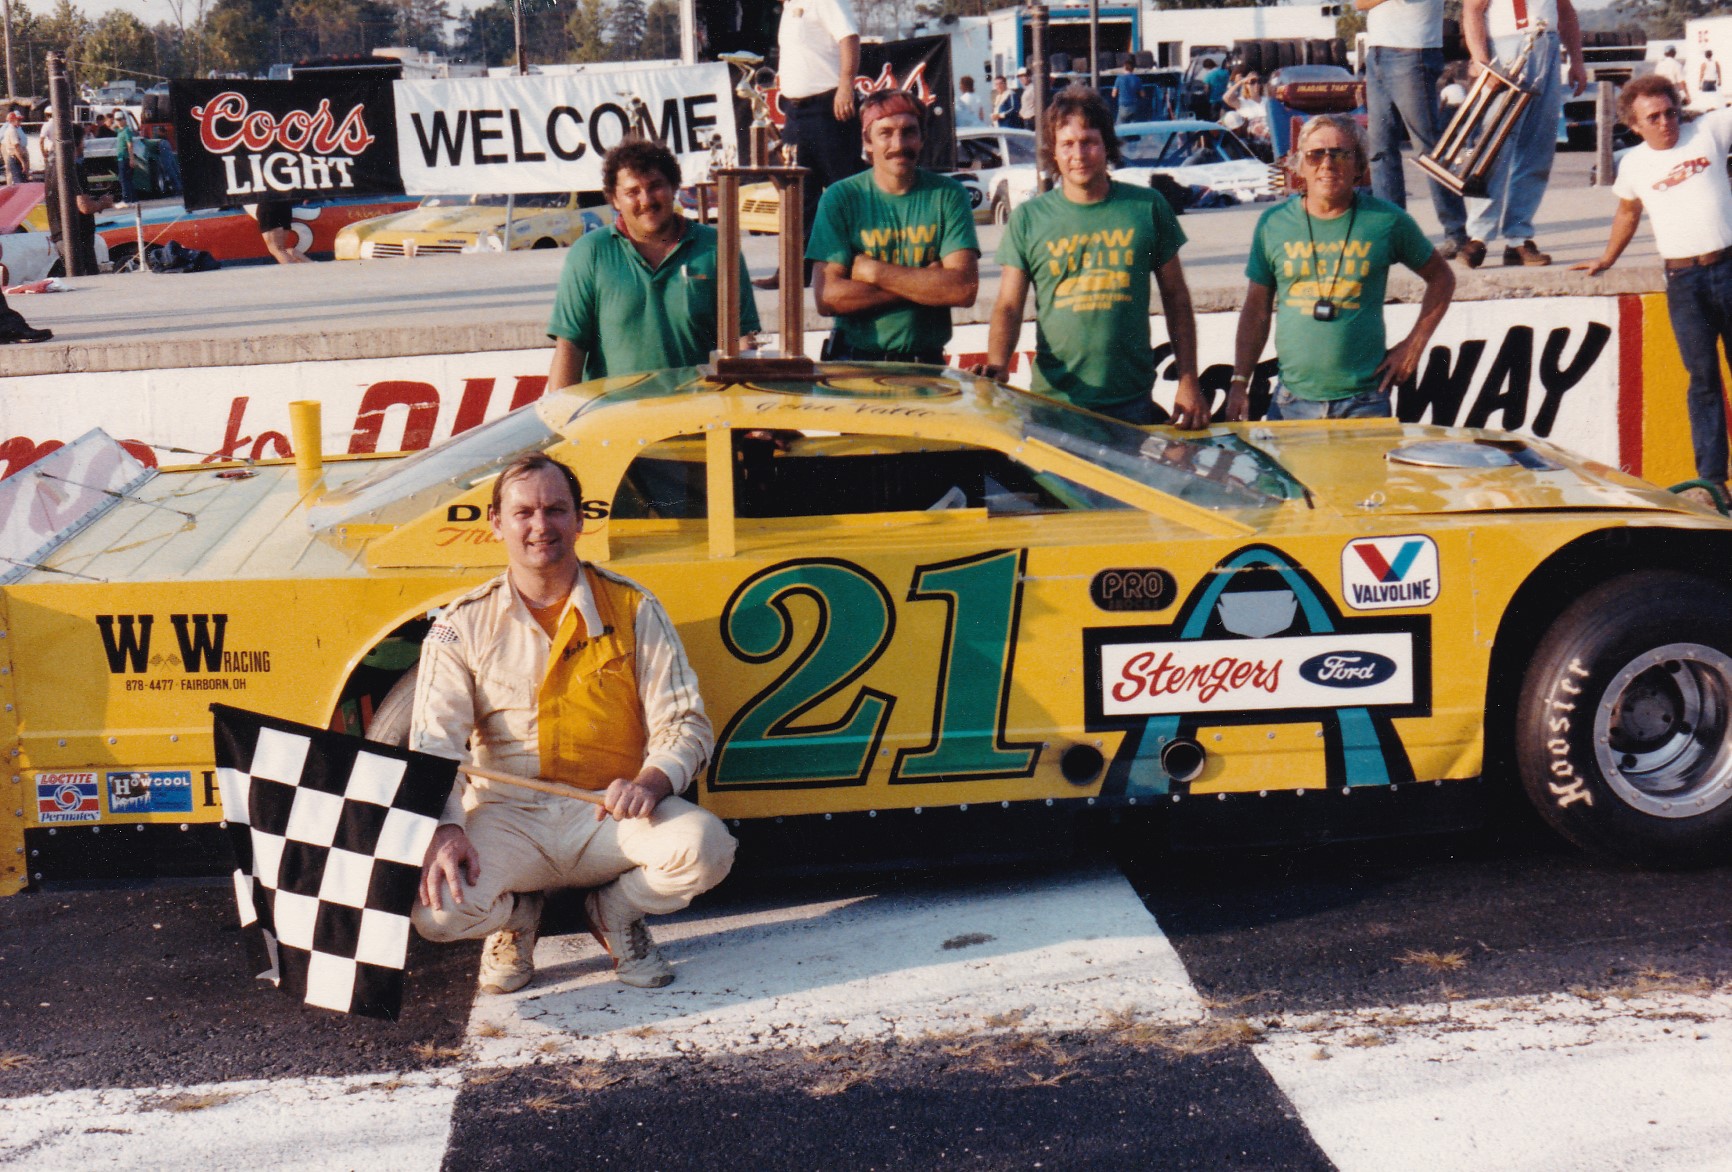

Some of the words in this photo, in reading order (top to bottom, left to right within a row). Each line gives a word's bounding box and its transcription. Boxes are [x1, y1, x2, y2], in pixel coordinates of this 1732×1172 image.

[191, 91, 375, 155] Coors
[410, 94, 718, 168] WELCOME
[221, 152, 355, 195] LIGHT
[1102, 572, 1164, 599] PRO
[1352, 578, 1432, 604] VALVOLINE
[224, 651, 271, 673] RACING
[707, 548, 1043, 793] 21
[1111, 651, 1284, 704] Stengers
[1317, 656, 1374, 680] Ford
[126, 679, 174, 691] 878-4477
[233, 678, 247, 690] OH
[40, 773, 93, 785] LOCTITE
